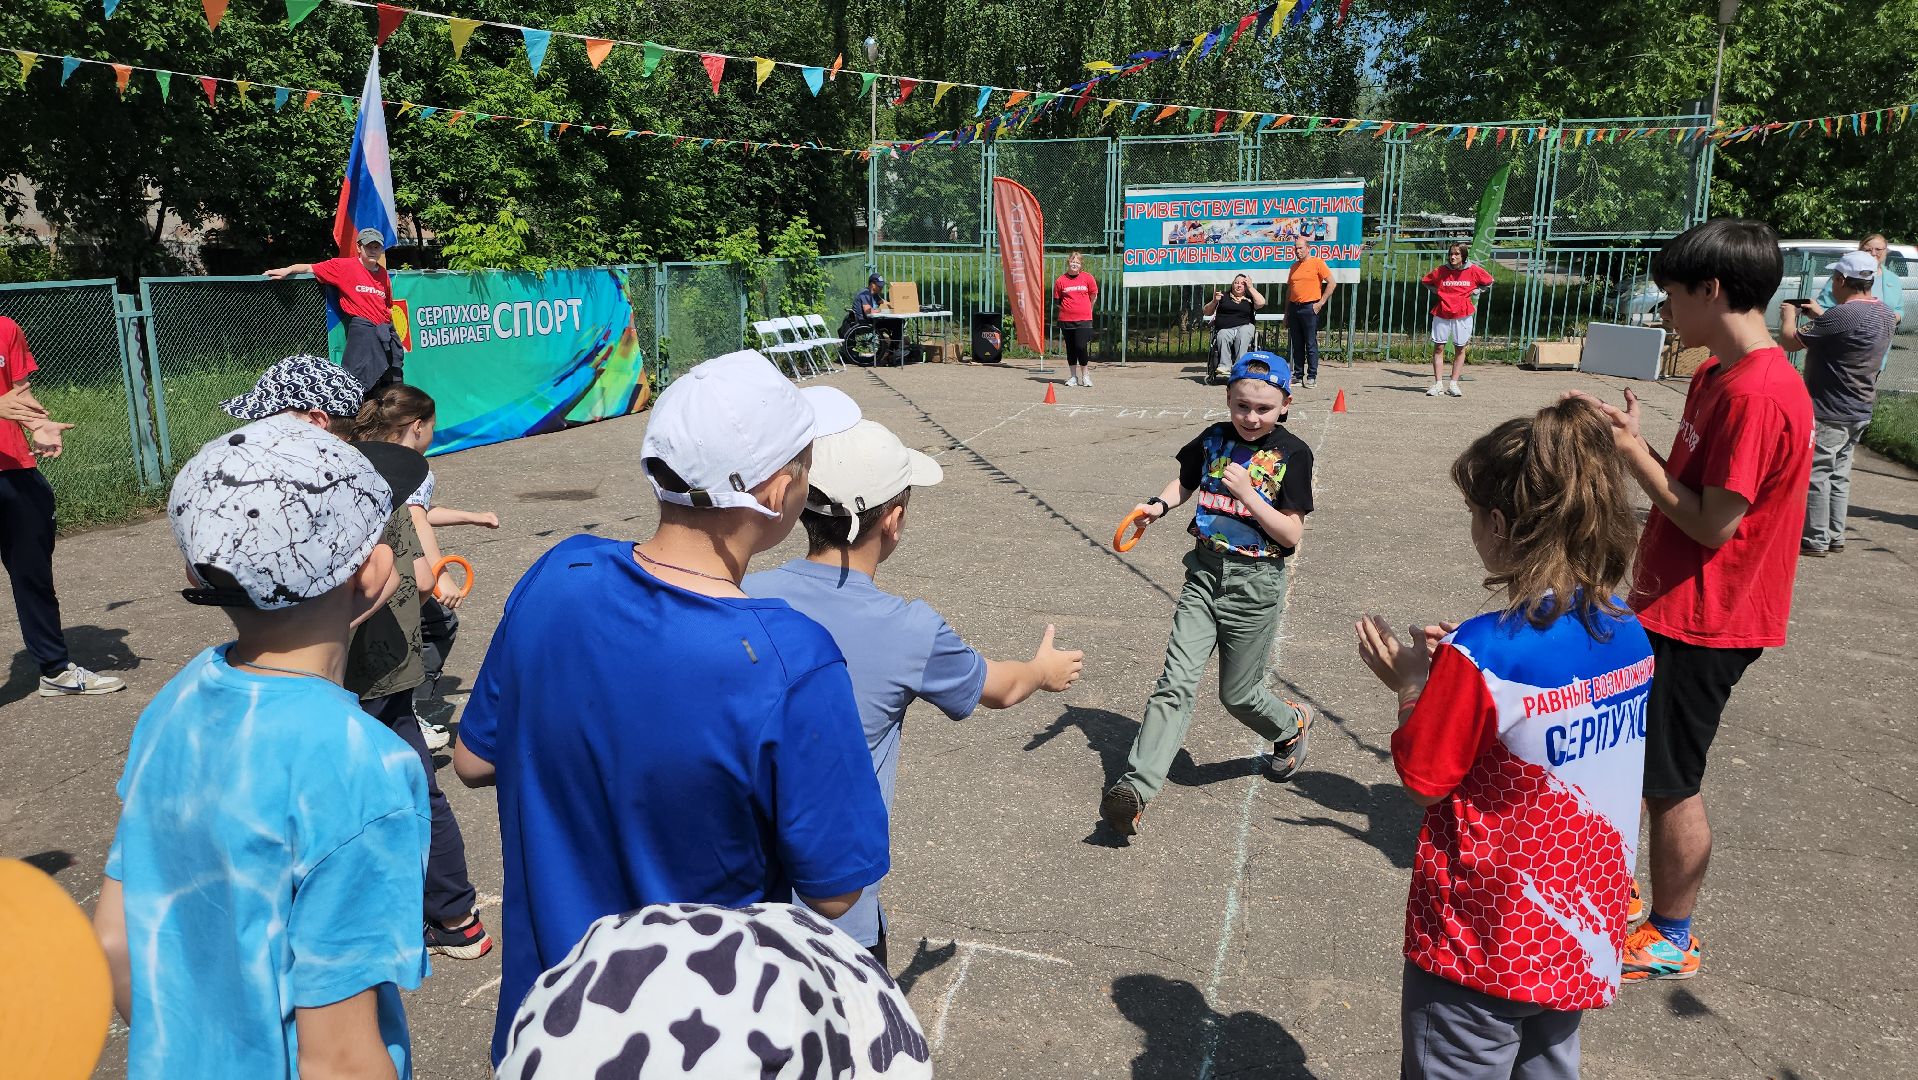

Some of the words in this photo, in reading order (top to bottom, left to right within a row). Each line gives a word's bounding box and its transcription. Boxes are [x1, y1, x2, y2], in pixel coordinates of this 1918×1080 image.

[1124, 197, 1258, 220] ПРИВЕТСТВУЕМ
[1124, 245, 1236, 266] СПОРТИВНЫХ
[1239, 243, 1361, 263] СОРЕВОВАНИ
[416, 304, 491, 327] СЕРПУХОВ
[492, 298, 583, 339] СПОРТ
[420, 325, 492, 348] ВЫБИРАЕТ
[1523, 679, 1592, 719] РАВНЫЕ
